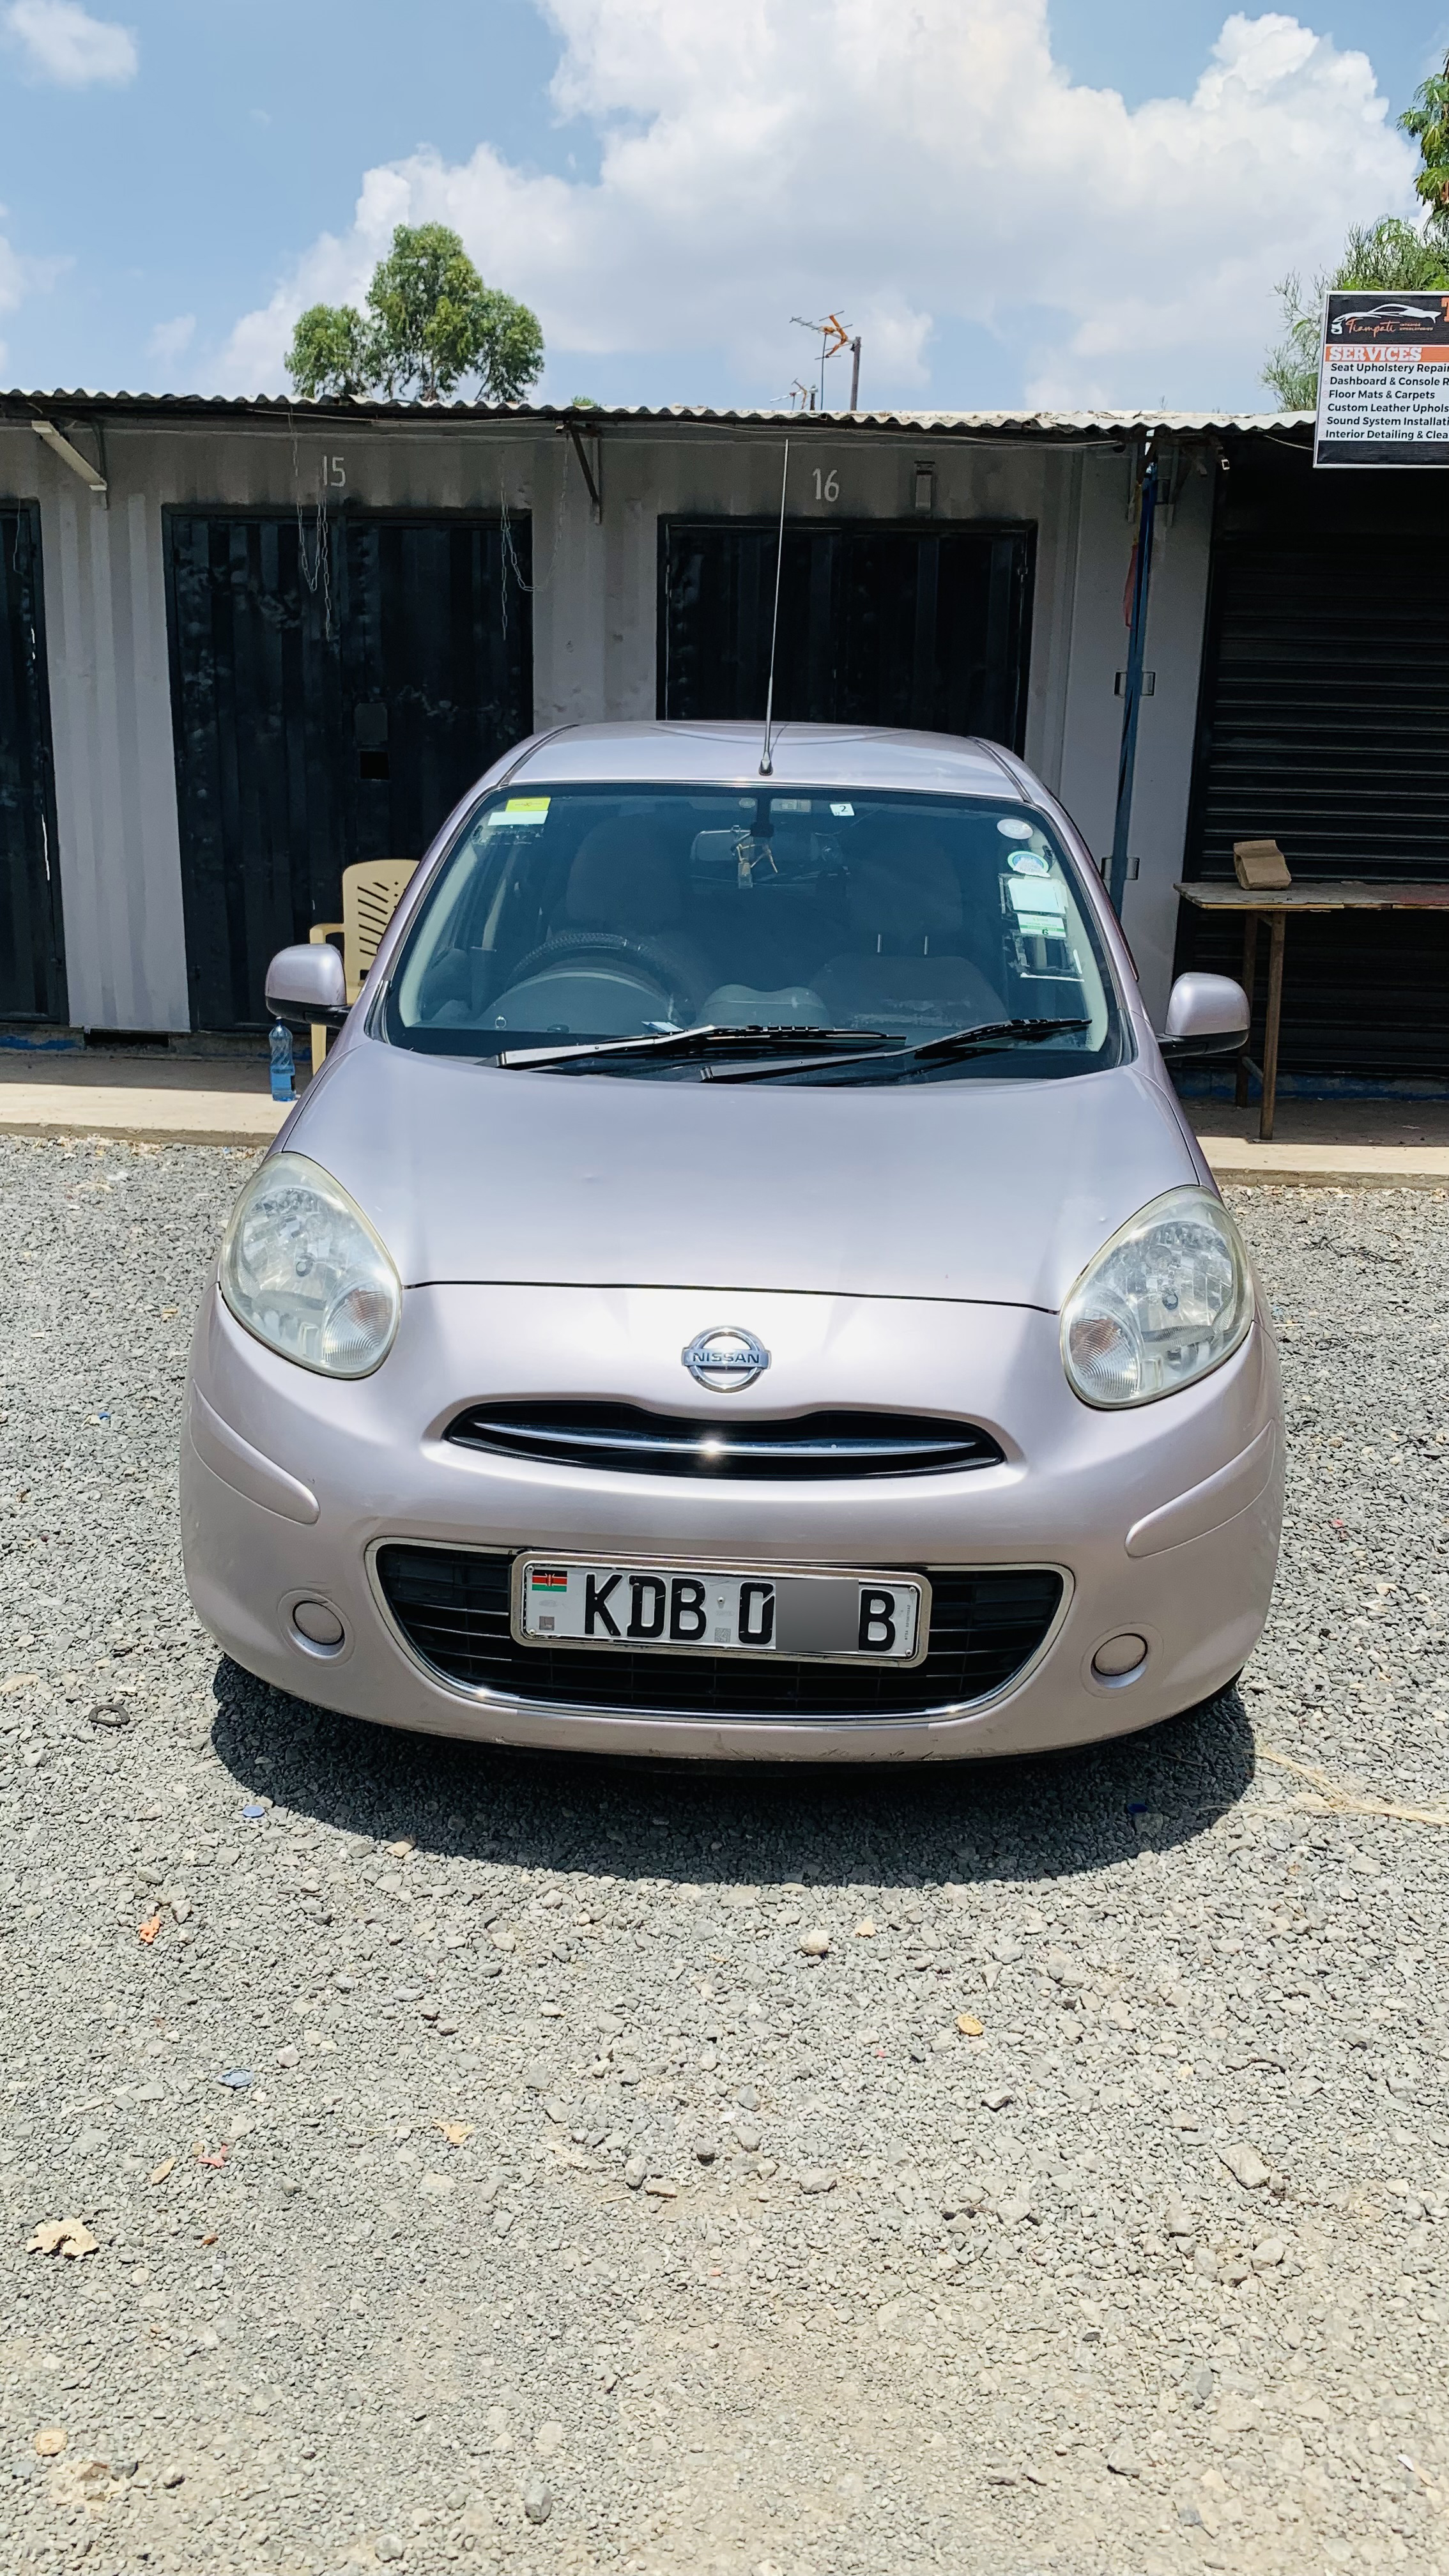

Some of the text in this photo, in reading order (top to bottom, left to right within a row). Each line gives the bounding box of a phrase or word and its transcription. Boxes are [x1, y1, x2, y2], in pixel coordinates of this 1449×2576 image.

[1329, 346, 1422, 362] SERVICES
[1331, 363, 1354, 371] Seat
[1356, 363, 1414, 374] Upholstery
[1330, 376, 1387, 385] Dashboard
[1390, 377, 1396, 385] &
[1399, 377, 1440, 386] Console
[1329, 390, 1435, 401] Floor Mats & Carpets
[1328, 403, 1449, 414] Custom Leather Uphols
[1327, 417, 1360, 425] Sound
[1362, 417, 1401, 427] System
[1326, 429, 1365, 438] Interior
[1367, 429, 1414, 440] Detailing
[1417, 431, 1423, 439] &
[323, 456, 346, 487] 15
[812, 468, 840, 502] 16
[693, 1352, 760, 1363] NISSAN
[585, 1574, 707, 1641] KDB
